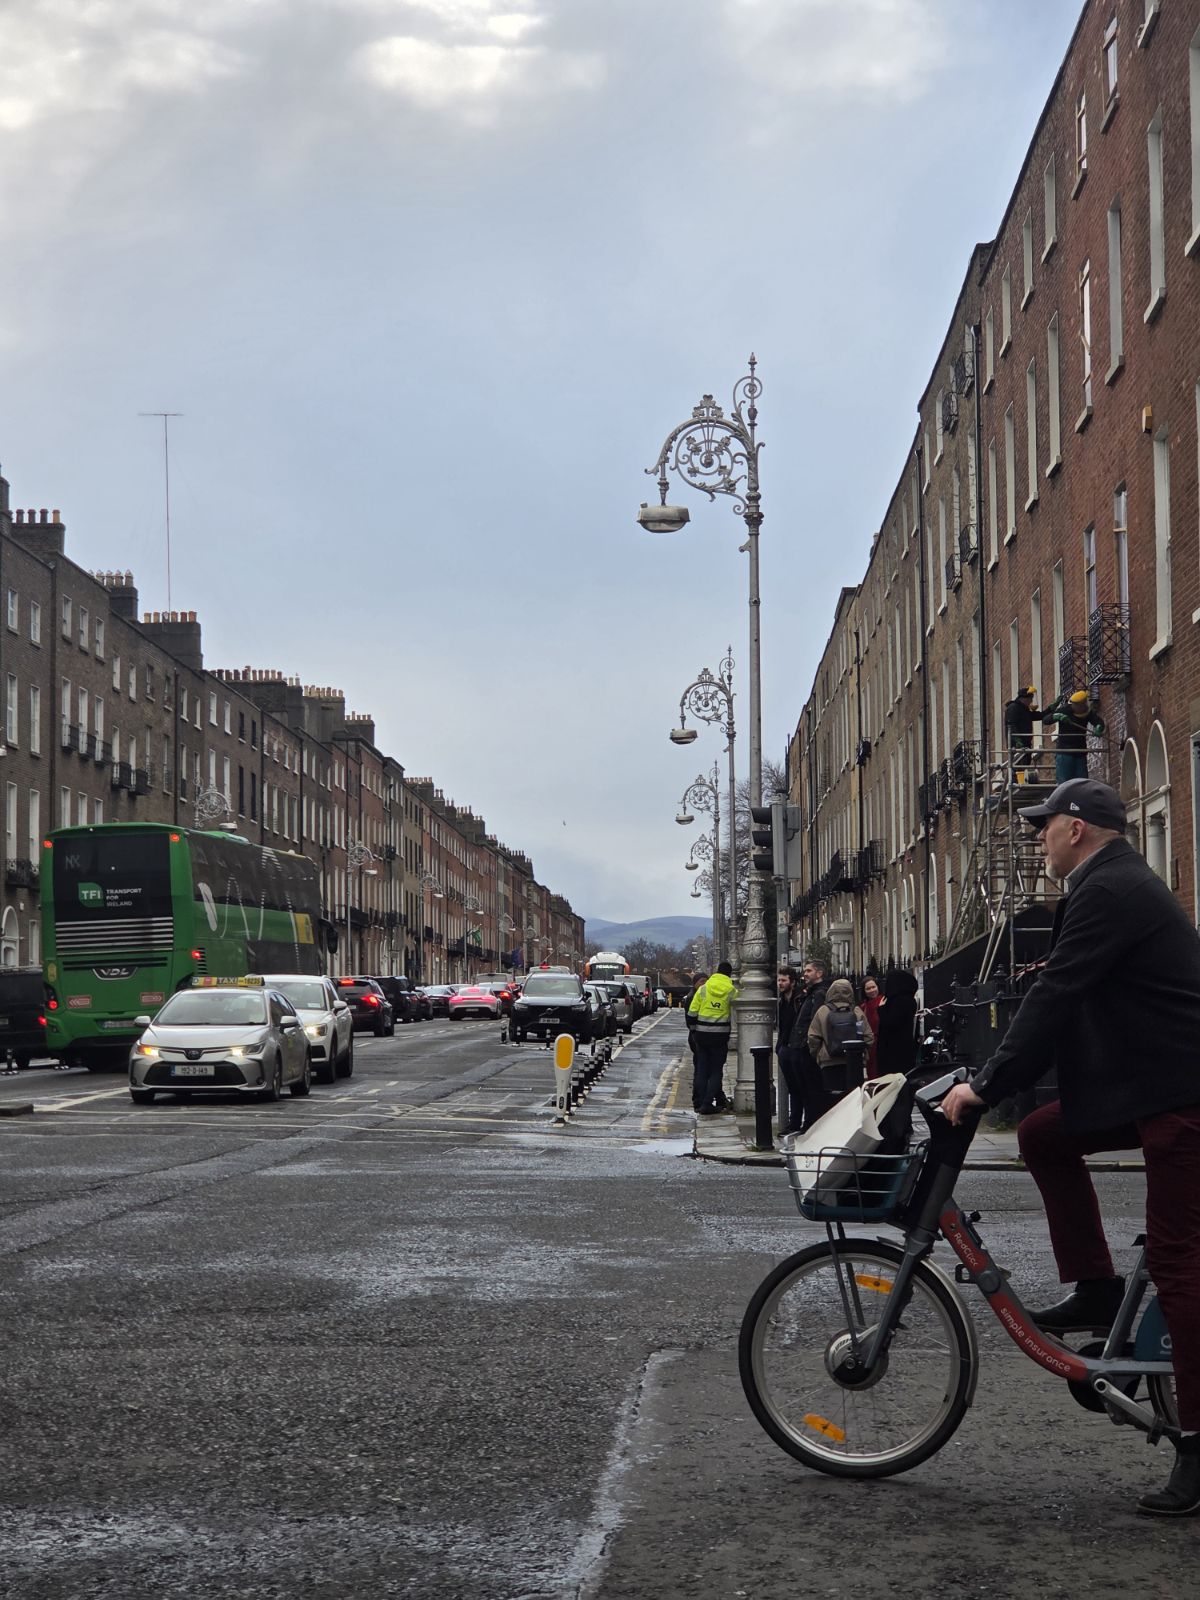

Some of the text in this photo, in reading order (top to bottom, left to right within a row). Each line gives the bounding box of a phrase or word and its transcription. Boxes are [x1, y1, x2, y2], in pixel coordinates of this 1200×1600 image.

[81, 890, 101, 900] TFI
[100, 968, 129, 976] VDL
[1000, 1307, 1071, 1372] simple insurance
